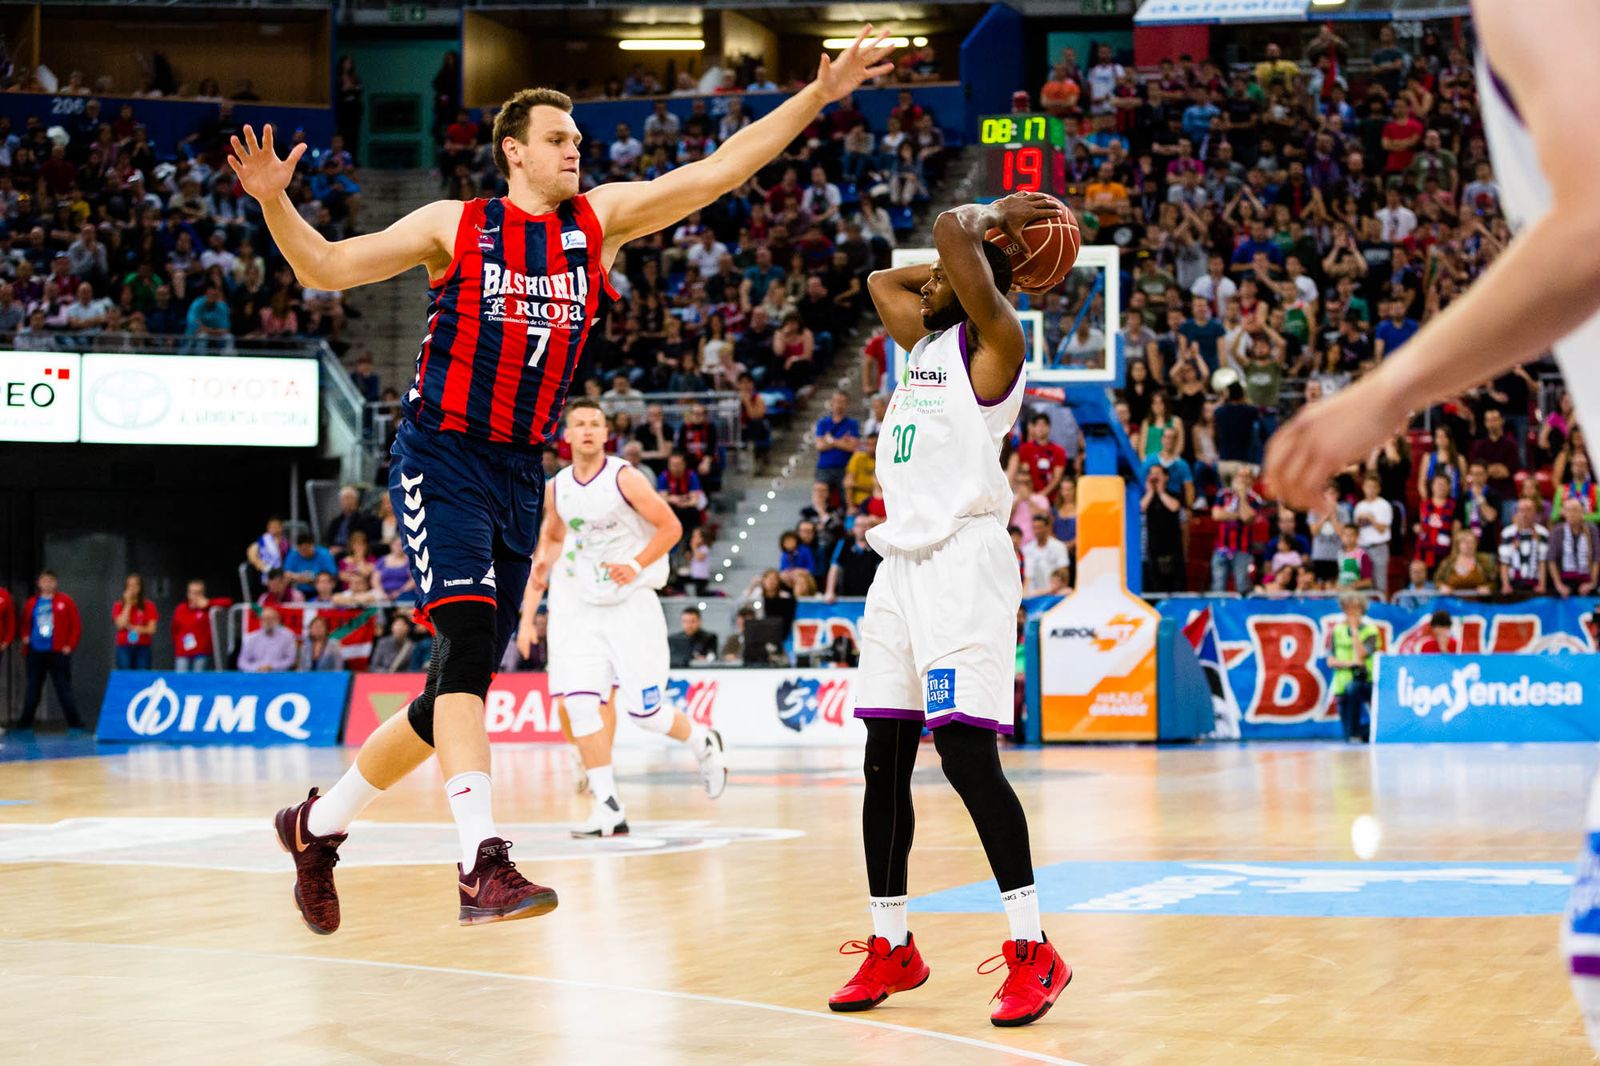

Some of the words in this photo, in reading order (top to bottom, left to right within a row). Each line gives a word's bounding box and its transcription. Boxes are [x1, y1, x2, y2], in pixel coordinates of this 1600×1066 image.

[981, 117, 1046, 144] 08:17
[1003, 148, 1043, 191] 19
[483, 262, 588, 306] BASKONIA
[526, 326, 552, 368] 7
[0, 382, 55, 408] EO
[190, 377, 300, 399] TOYOTA
[892, 424, 917, 464] 20
[1398, 666, 1455, 718] liga
[1468, 674, 1583, 707] endesa
[178, 692, 312, 740] IMQ
